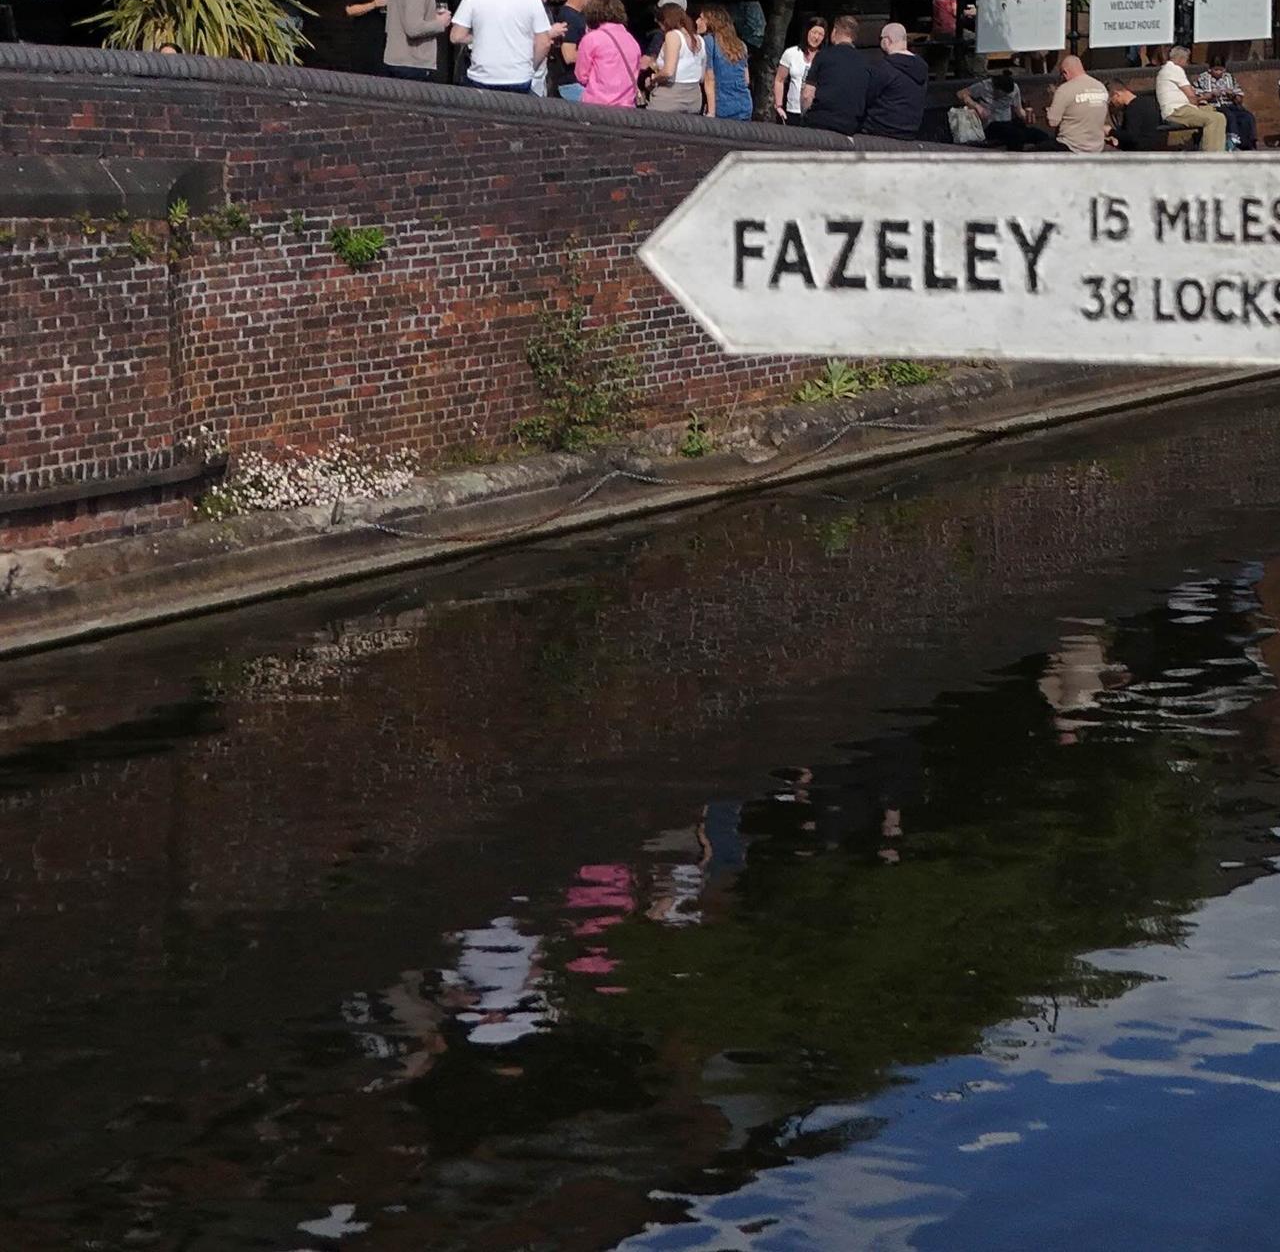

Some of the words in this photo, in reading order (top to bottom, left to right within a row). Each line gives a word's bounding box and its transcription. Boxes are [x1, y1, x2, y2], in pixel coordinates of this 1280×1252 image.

[1103, 21, 1117, 31] THE
[1118, 20, 1136, 30] MALT
[1137, 19, 1160, 30] HOUSE
[1110, 0, 1144, 11] WELCOME
[1088, 193, 1129, 244] 15
[732, 218, 1058, 294] FAZELEY
[1080, 275, 1136, 320] 38
